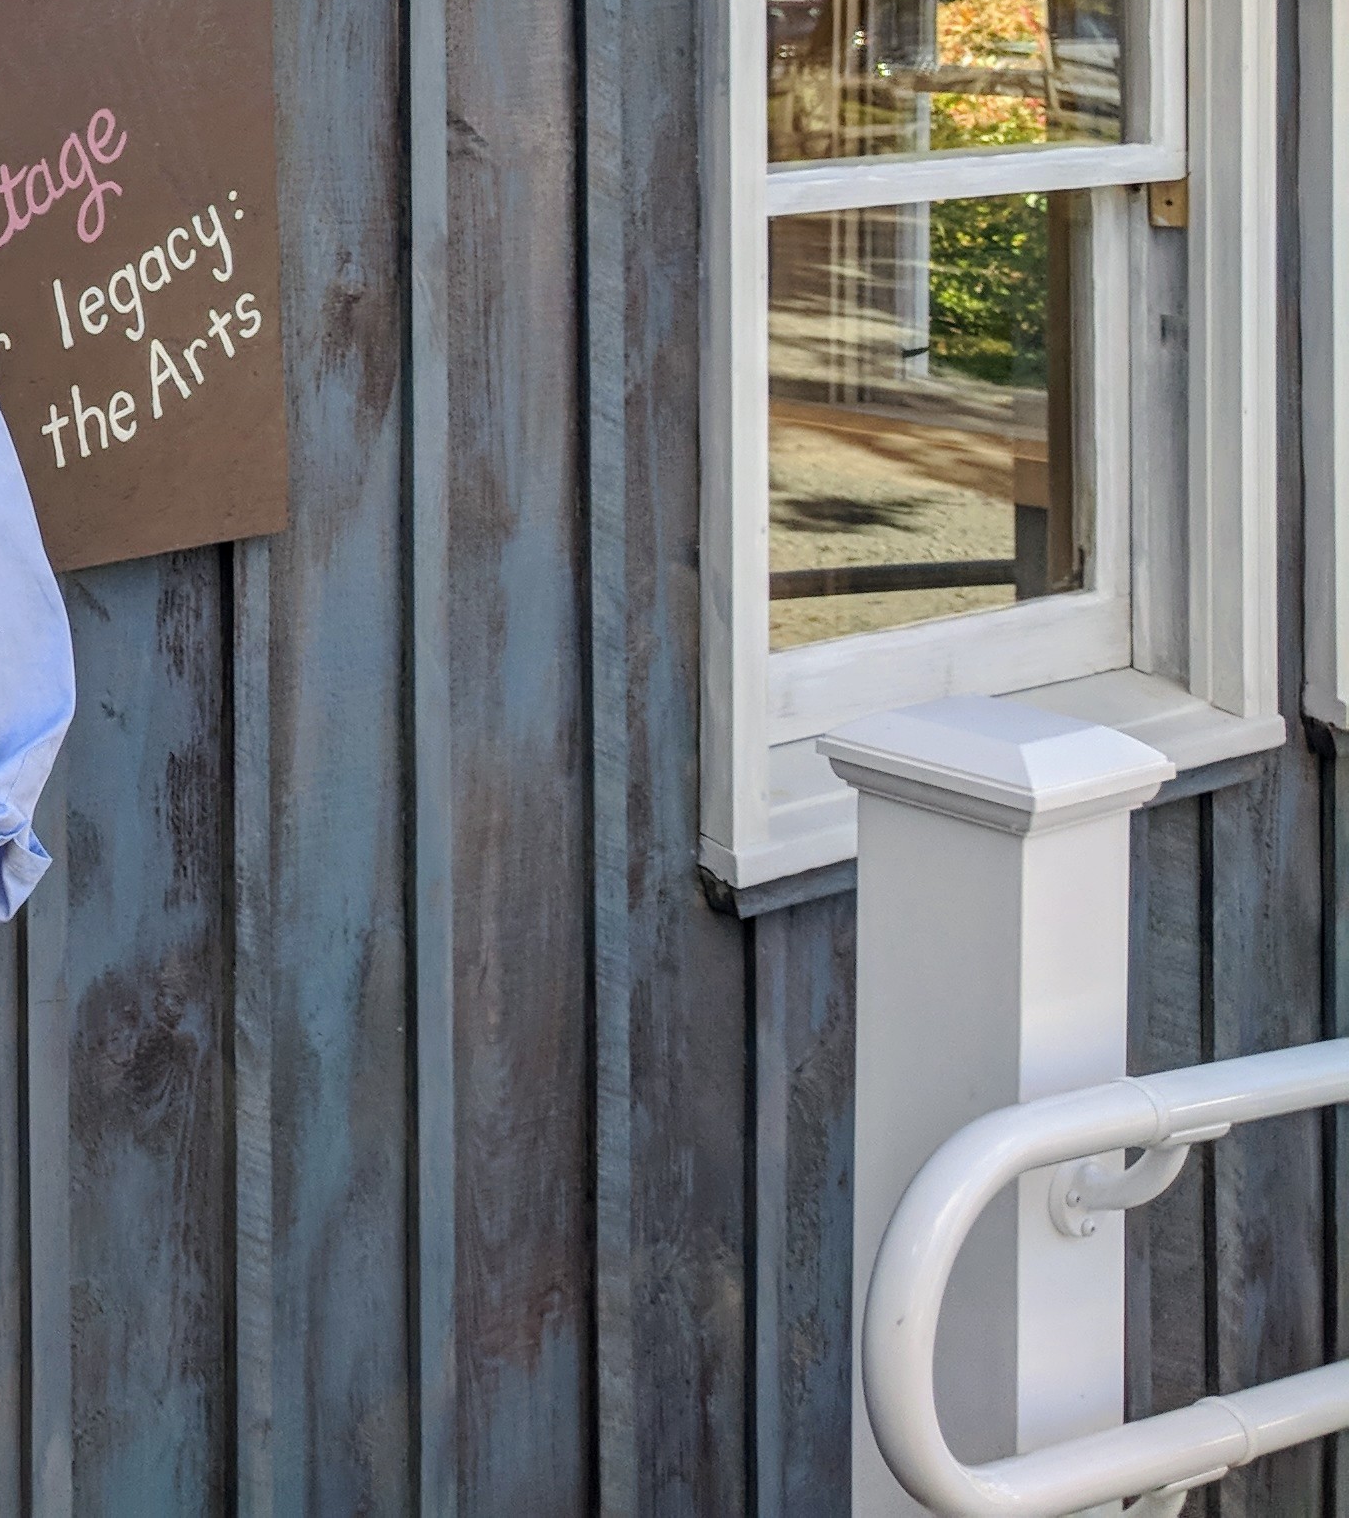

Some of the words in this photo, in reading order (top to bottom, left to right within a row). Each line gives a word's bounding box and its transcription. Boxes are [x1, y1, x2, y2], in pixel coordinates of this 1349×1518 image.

[52, 189, 245, 350] legacy:
[41, 384, 137, 469] the
[149, 292, 263, 420] Arts
